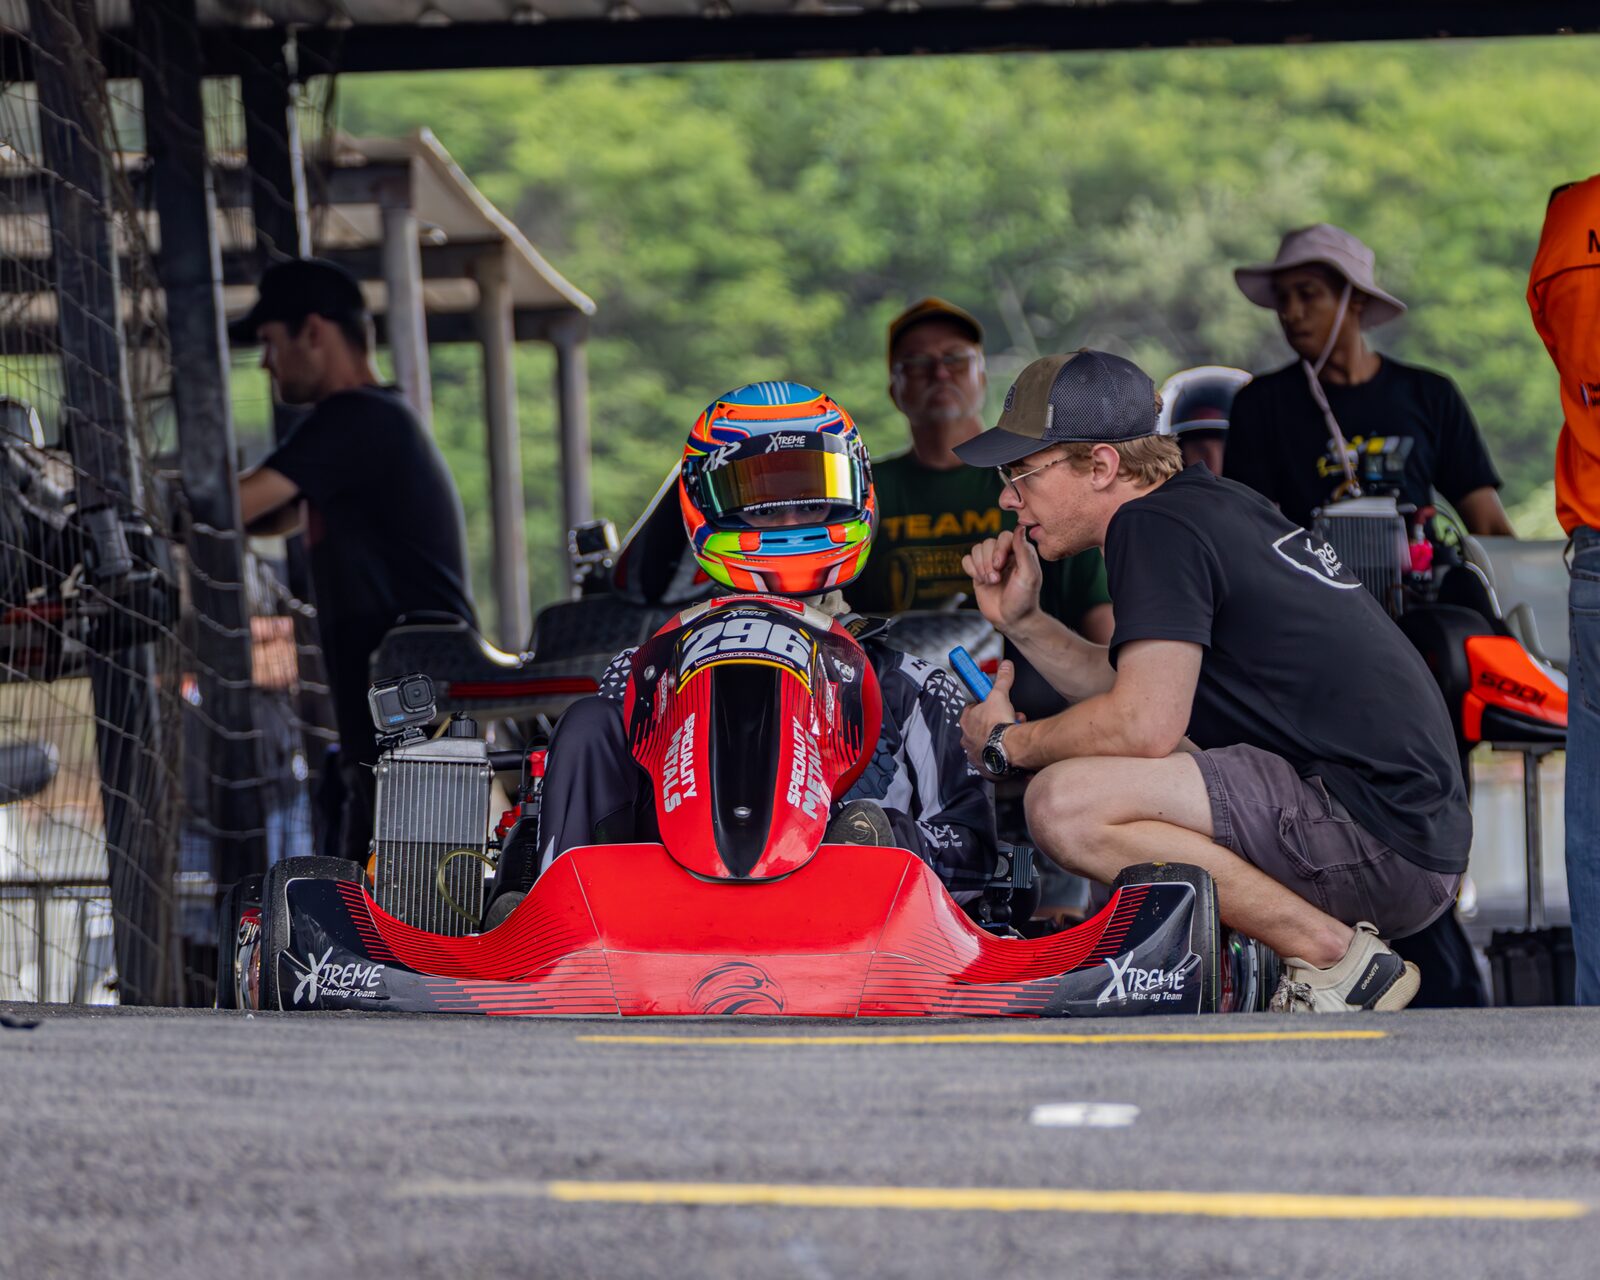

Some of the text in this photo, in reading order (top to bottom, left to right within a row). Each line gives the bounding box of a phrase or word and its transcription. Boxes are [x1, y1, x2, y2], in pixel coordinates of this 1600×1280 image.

[765, 431, 806, 454] XTREME
[881, 508, 1001, 541] TEAM
[680, 618, 812, 676] 296
[662, 726, 683, 813] METALS
[787, 716, 807, 808] SPECIALITY
[801, 729, 825, 820] METALS
[293, 946, 385, 1004] XTREME
[320, 987, 376, 998] Racing Team
[1097, 951, 1185, 1007] XTREME
[1162, 991, 1183, 1001] Team
